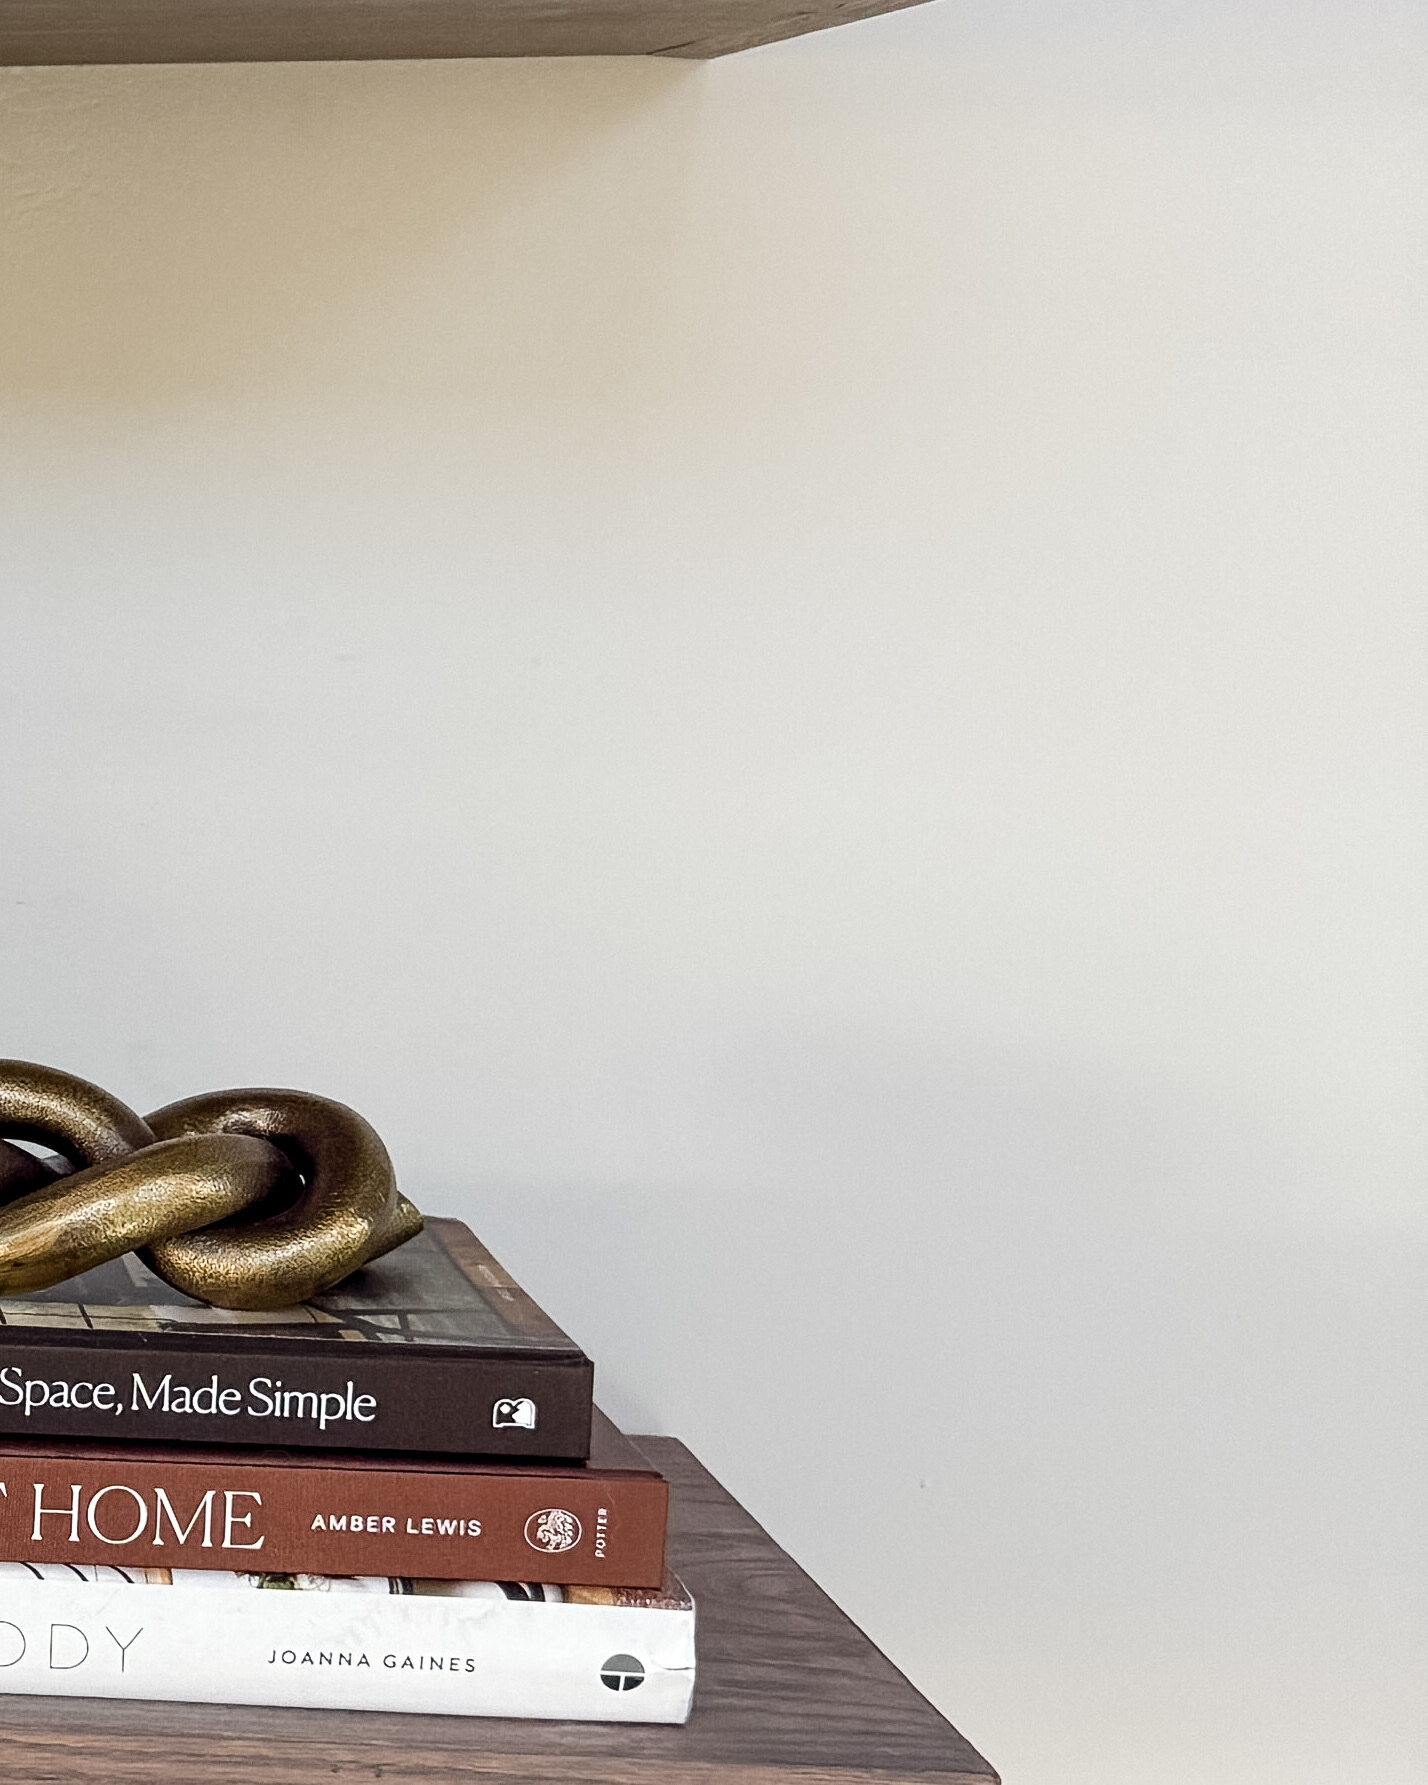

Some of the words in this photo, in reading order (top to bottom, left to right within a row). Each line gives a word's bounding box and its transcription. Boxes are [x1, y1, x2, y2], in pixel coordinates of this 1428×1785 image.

[130, 1372, 242, 1416] Made
[247, 1377, 377, 1433] Simple
[30, 1483, 265, 1550] HOME
[310, 1514, 396, 1534] AMBER
[406, 1517, 482, 1537] LEWIS
[594, 1507, 608, 1558] POTTER
[268, 1650, 370, 1667] JOANNA
[383, 1654, 475, 1673] GAINES
